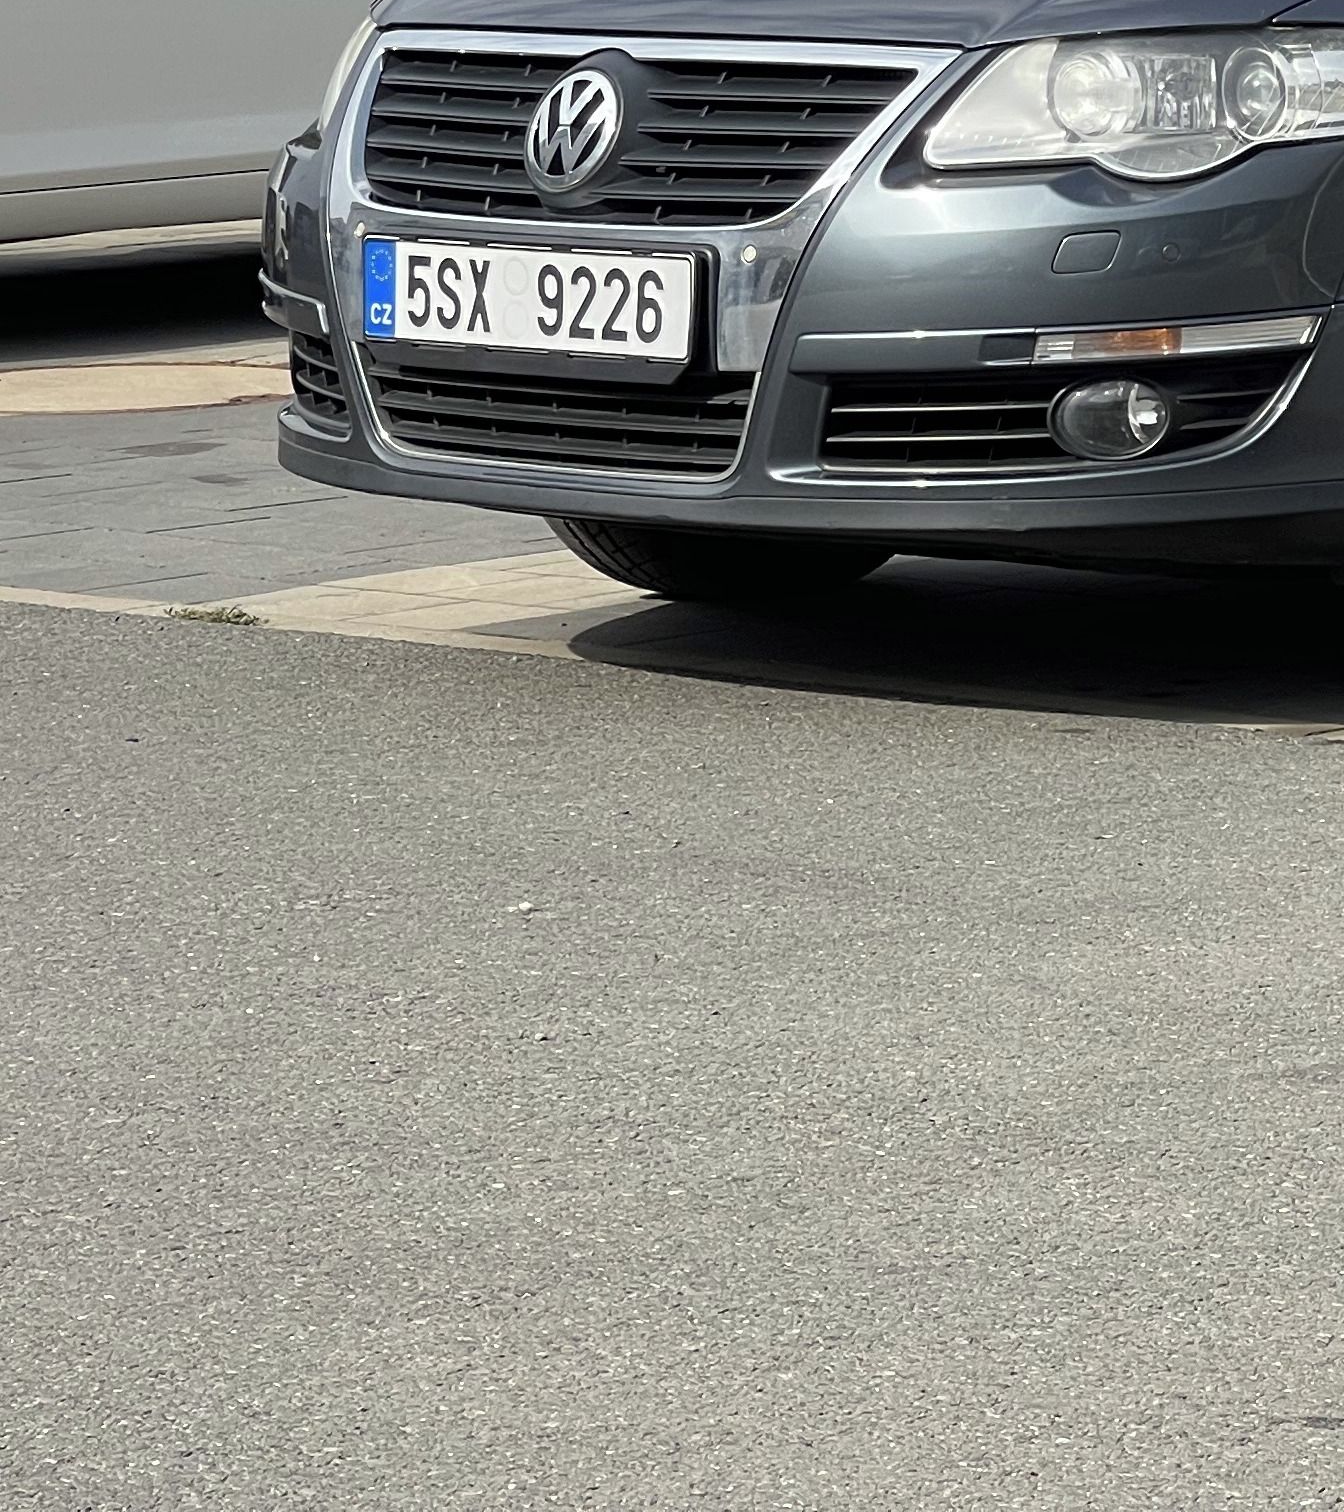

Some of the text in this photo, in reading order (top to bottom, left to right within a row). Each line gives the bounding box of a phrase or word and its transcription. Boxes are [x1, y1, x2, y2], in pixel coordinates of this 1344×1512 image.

[369, 304, 393, 326] CZ
[406, 254, 665, 344] 5SX 9226
